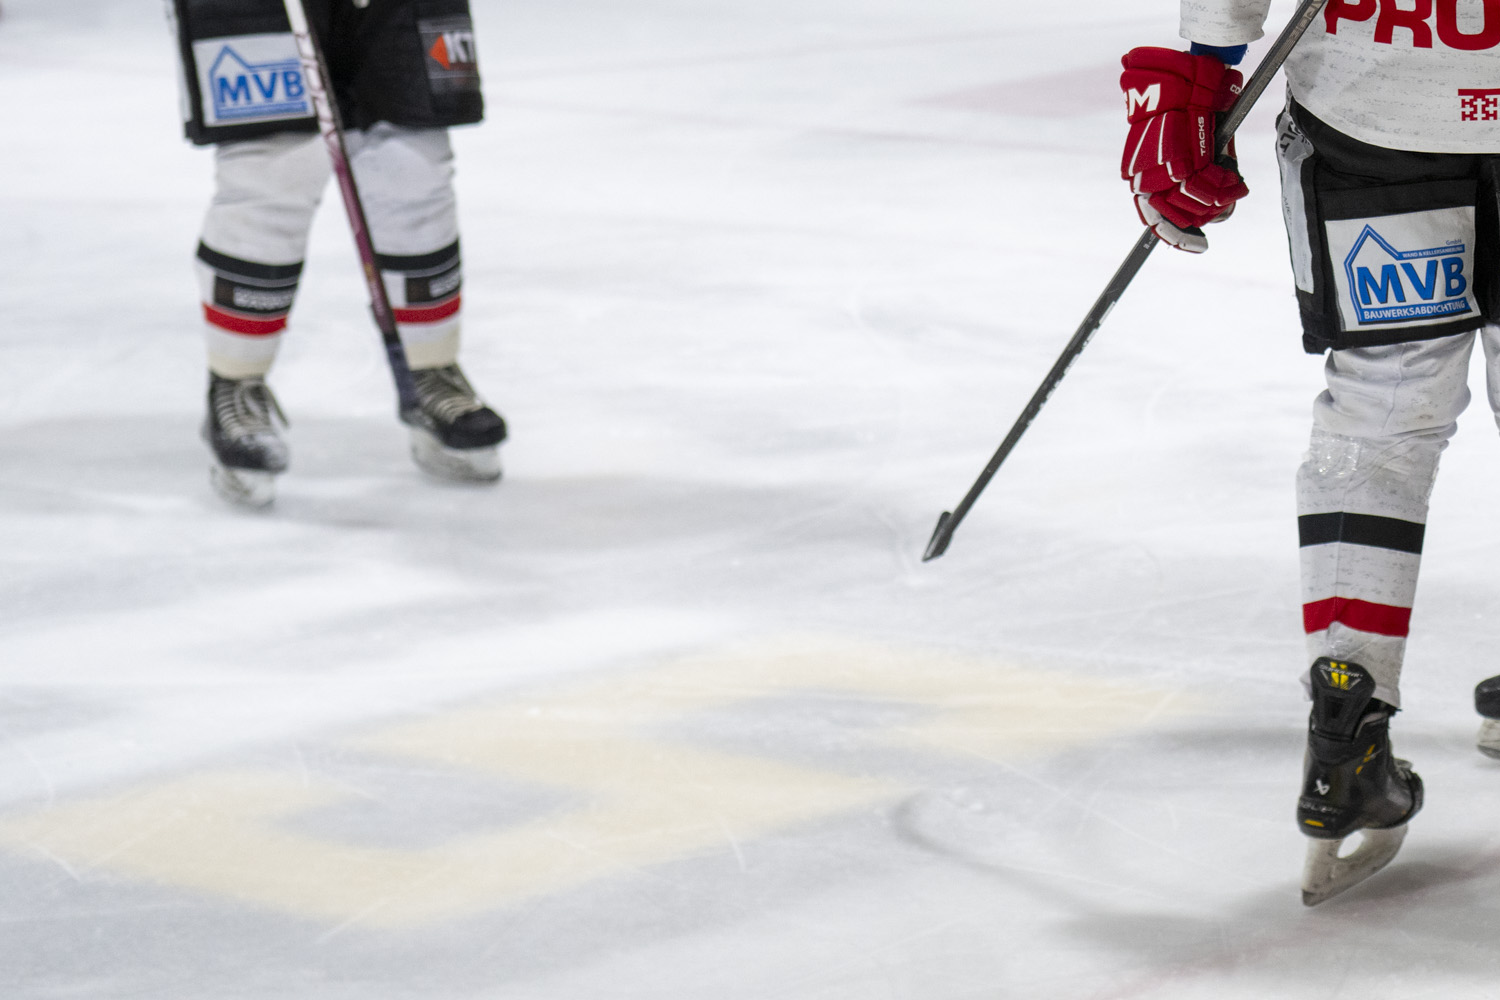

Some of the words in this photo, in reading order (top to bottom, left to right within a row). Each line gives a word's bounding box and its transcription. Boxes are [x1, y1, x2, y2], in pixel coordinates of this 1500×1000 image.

[219, 70, 305, 105] MVB
[1197, 116, 1206, 157] TACKS
[1356, 256, 1468, 306] MVB
[1363, 300, 1466, 320] BAUWERKSABDICHTUNG
